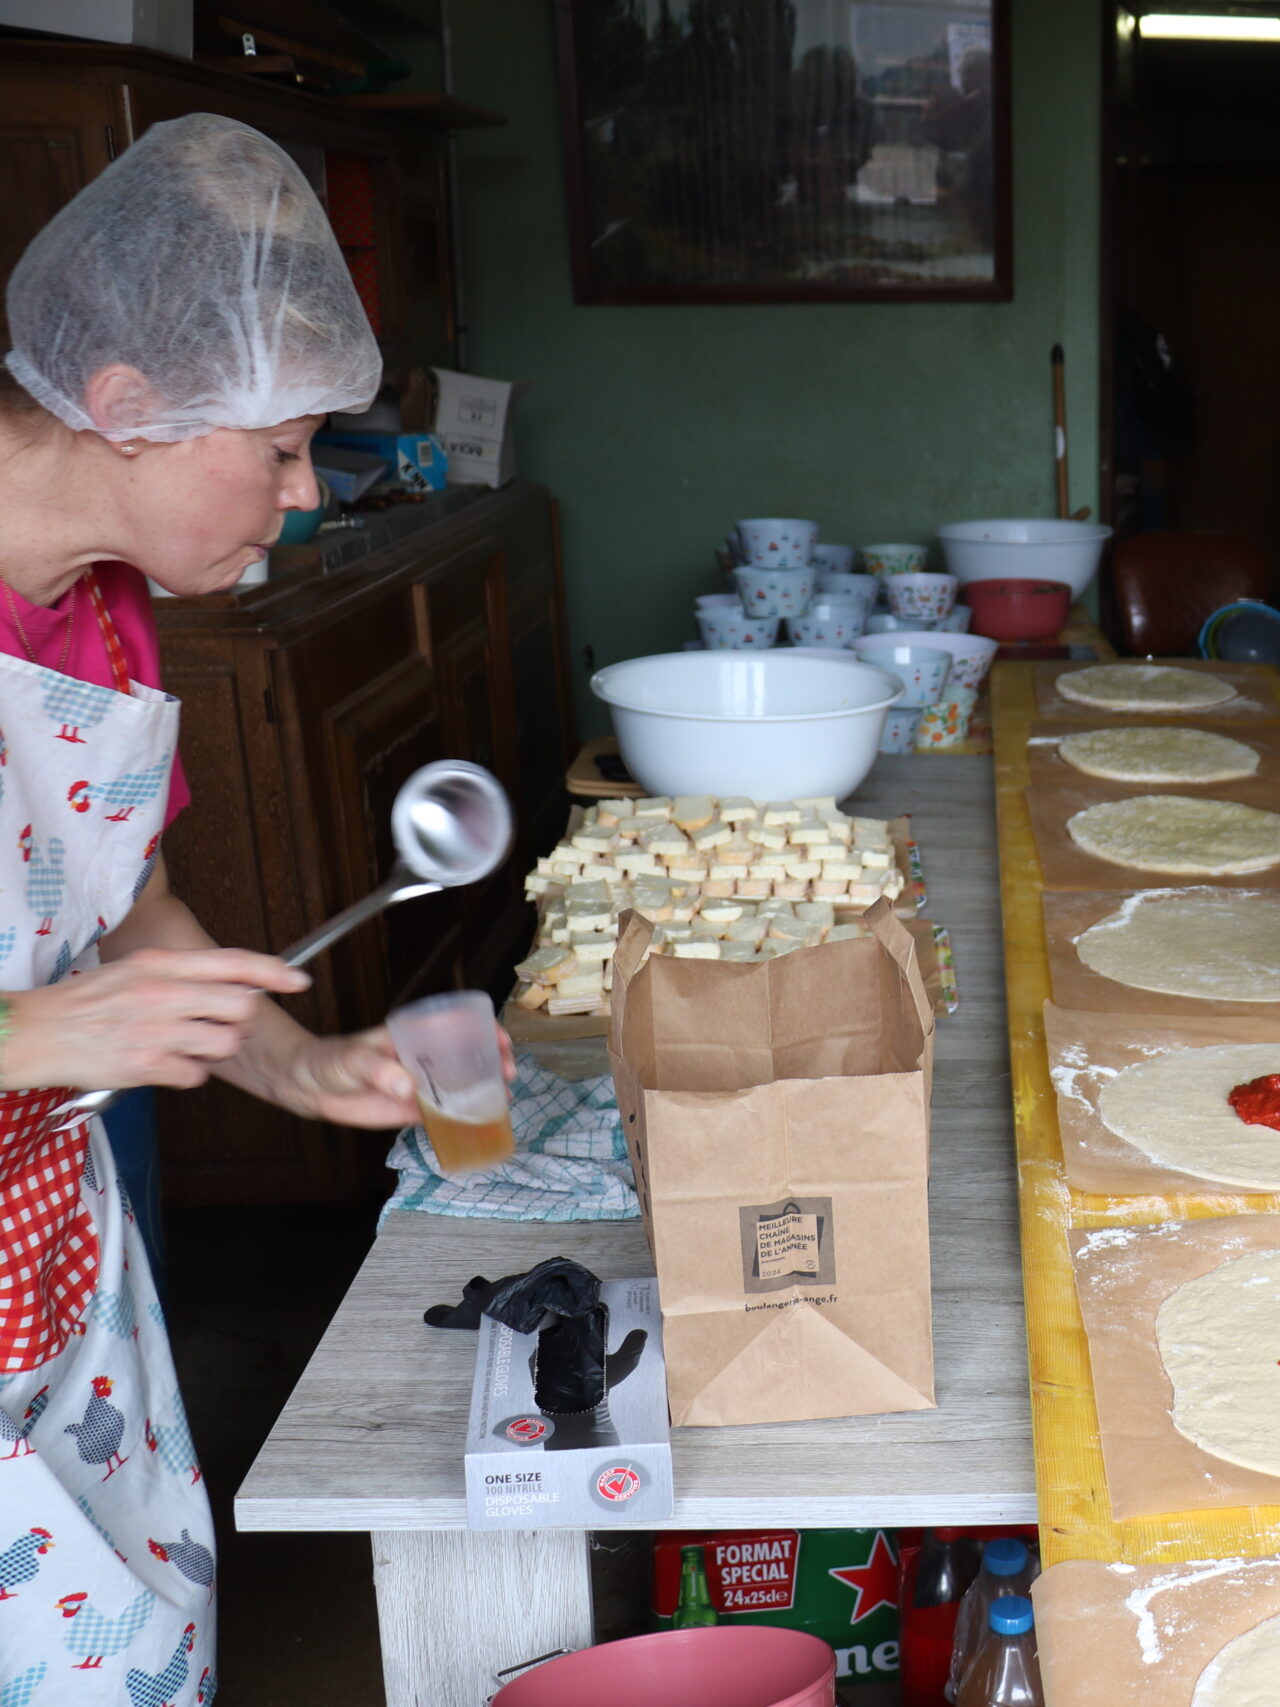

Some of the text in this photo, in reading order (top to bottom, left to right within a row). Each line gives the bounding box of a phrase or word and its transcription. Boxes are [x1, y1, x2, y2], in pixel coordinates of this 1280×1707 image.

[759, 1216, 803, 1231] MEILLEURE
[759, 1227, 790, 1240] CHAÎNE
[760, 1234, 816, 1249] DE MAGASINS
[774, 1243, 808, 1256] L'ANNÉE
[745, 1294, 838, 1312] boulangerie-ange.fr
[494, 1365, 510, 1397] GLOVES
[485, 1472, 542, 1485] ONE SIZE
[599, 1469, 615, 1487] HACCP
[485, 1483, 543, 1495] 100 NITRILE
[485, 1492, 560, 1507] DISPOSABLE
[486, 1505, 533, 1517] GLOVES
[716, 1540, 793, 1565] FORMAT
[721, 1561, 789, 1585] SPECIAL
